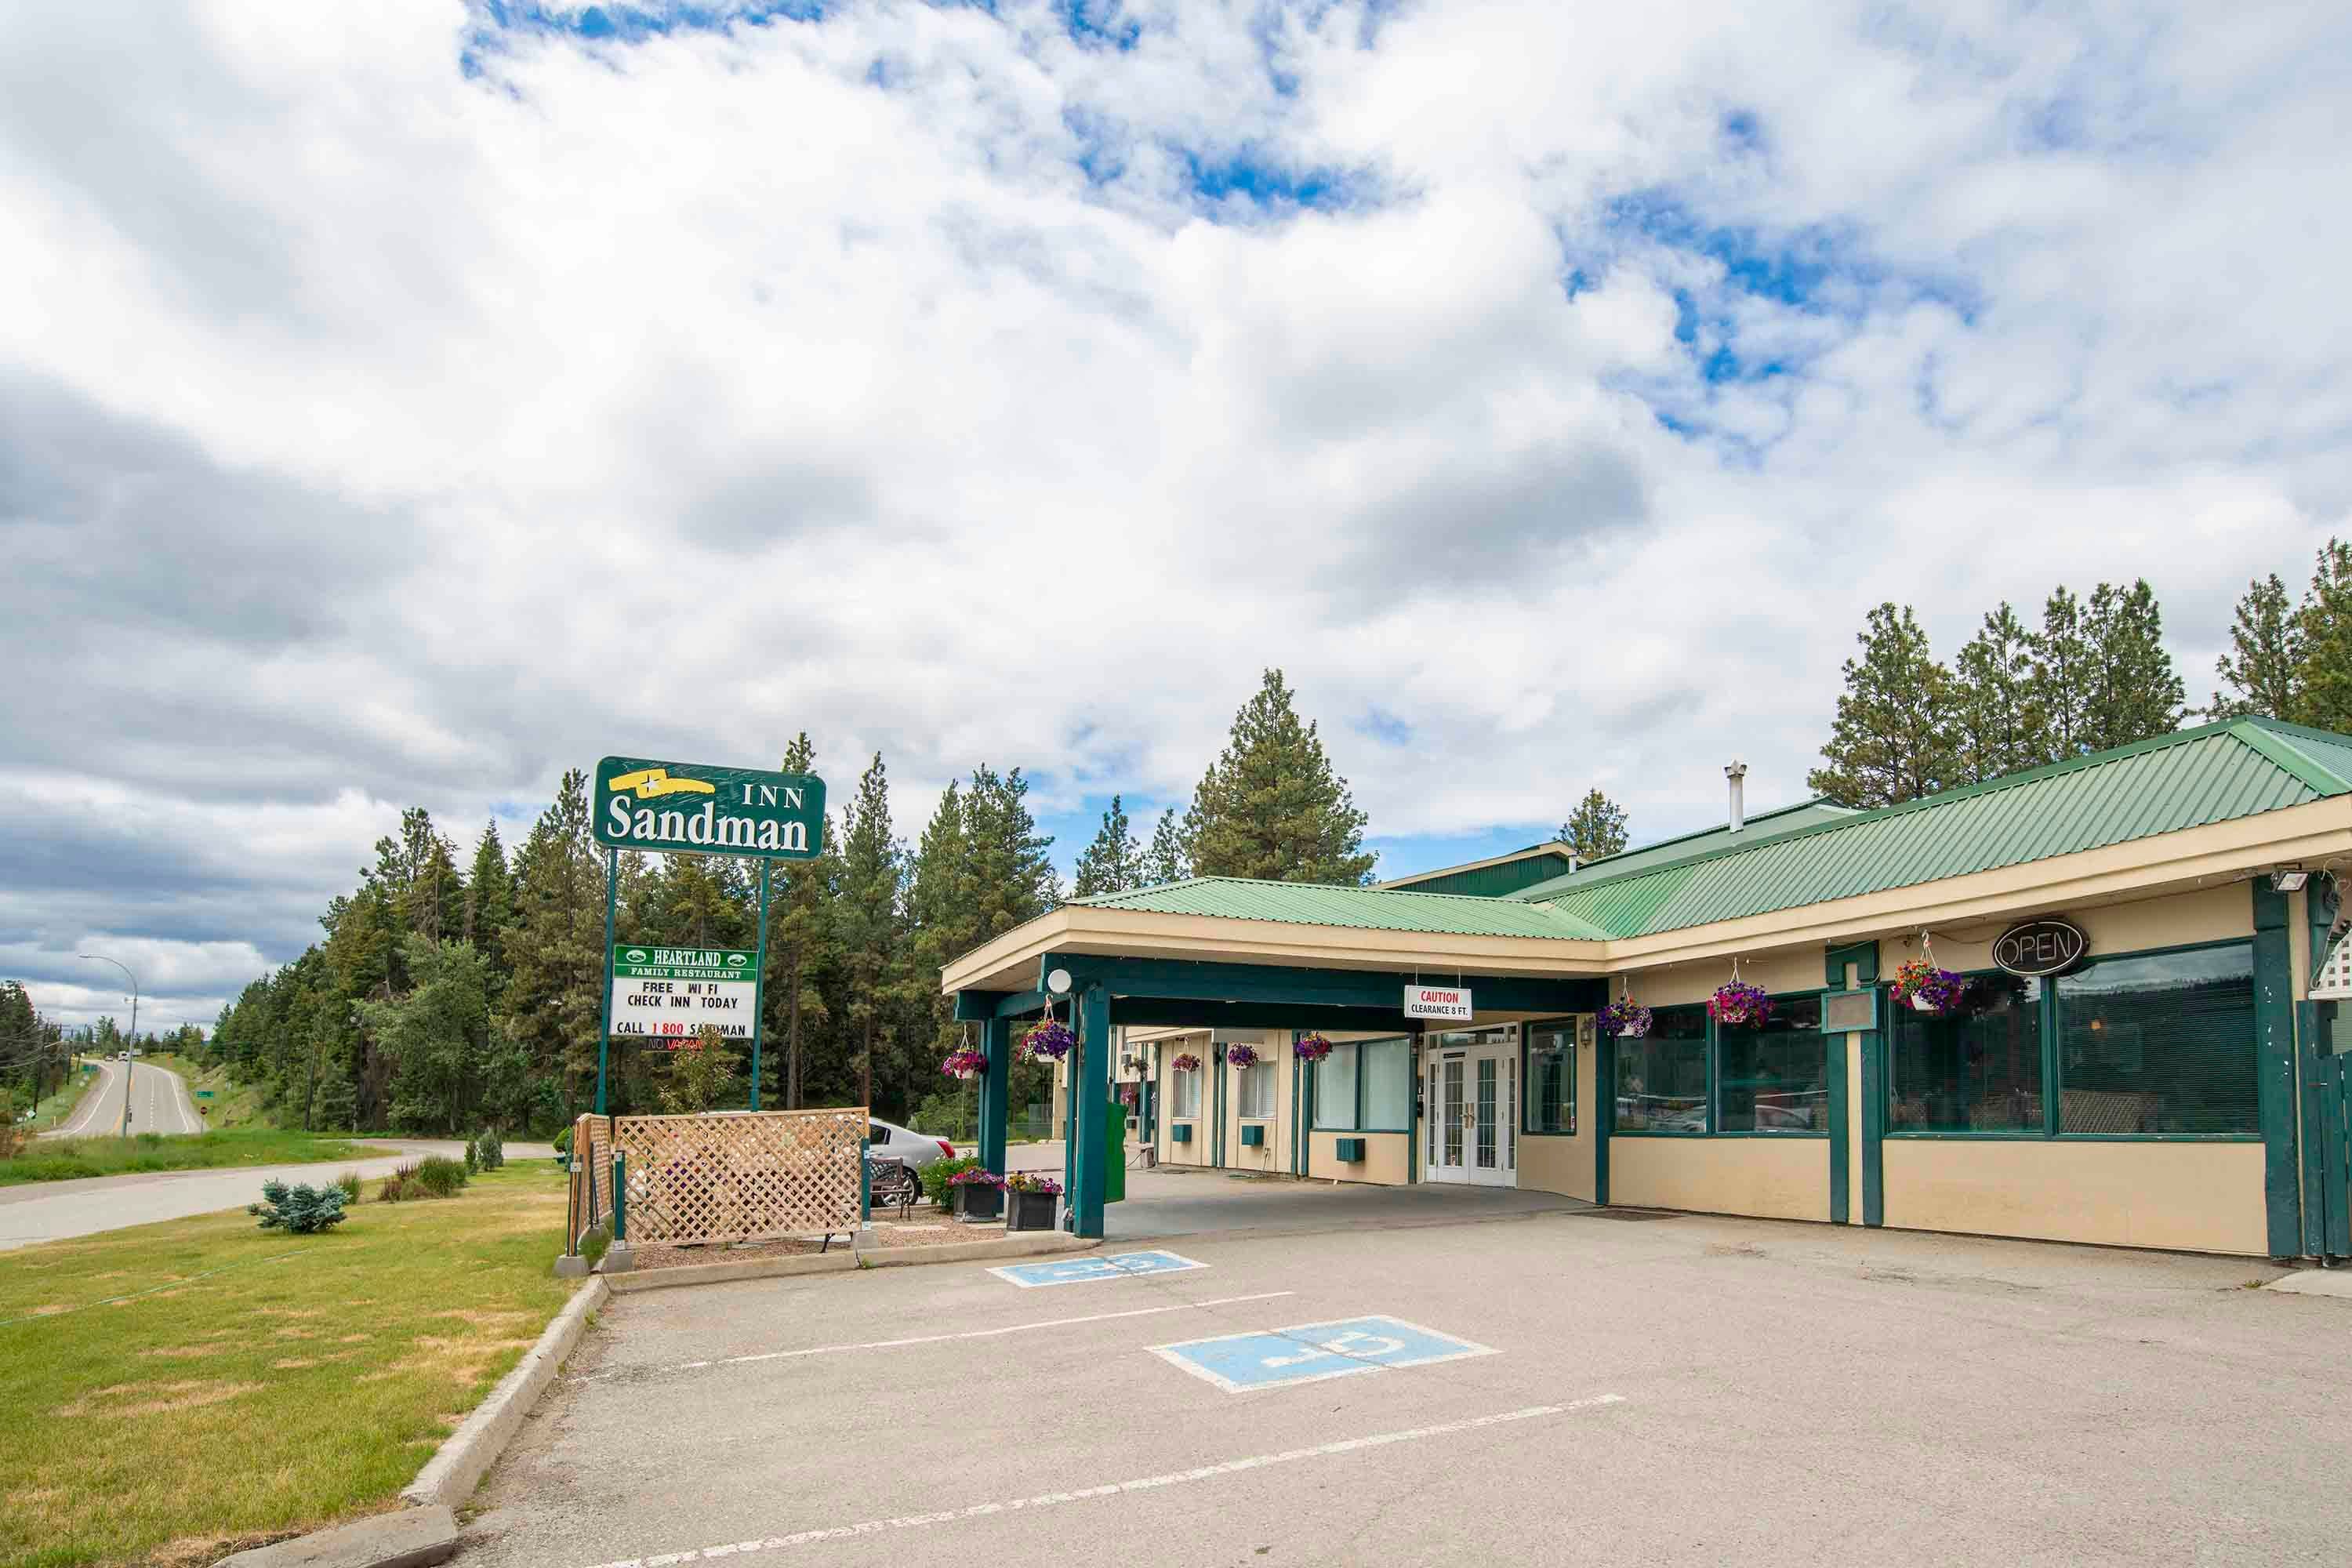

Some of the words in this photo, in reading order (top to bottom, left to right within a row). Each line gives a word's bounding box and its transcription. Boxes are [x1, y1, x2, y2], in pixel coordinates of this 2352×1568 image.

[742, 783, 804, 810] INN
[607, 794, 809, 852] Sandman
[1999, 930, 2071, 965] OPEN
[653, 949, 721, 967] HEARTLAND
[630, 967, 670, 977] FAMILY
[674, 969, 741, 979] RESTAURANT
[642, 982, 673, 993] FREE
[688, 983, 702, 994] WI
[708, 984, 718, 995] FI
[627, 995, 662, 1007] CHECK
[670, 996, 690, 1008] INN
[701, 996, 739, 1009] TODAY
[1421, 990, 1459, 1004] CAUTION
[1411, 1004, 1450, 1014] CLEARANCE
[1451, 1007, 1457, 1015] 8
[617, 1022, 645, 1034] CALL
[652, 1022, 657, 1034] 1
[662, 1023, 684, 1035] 800
[648, 1039, 664, 1049] NO
